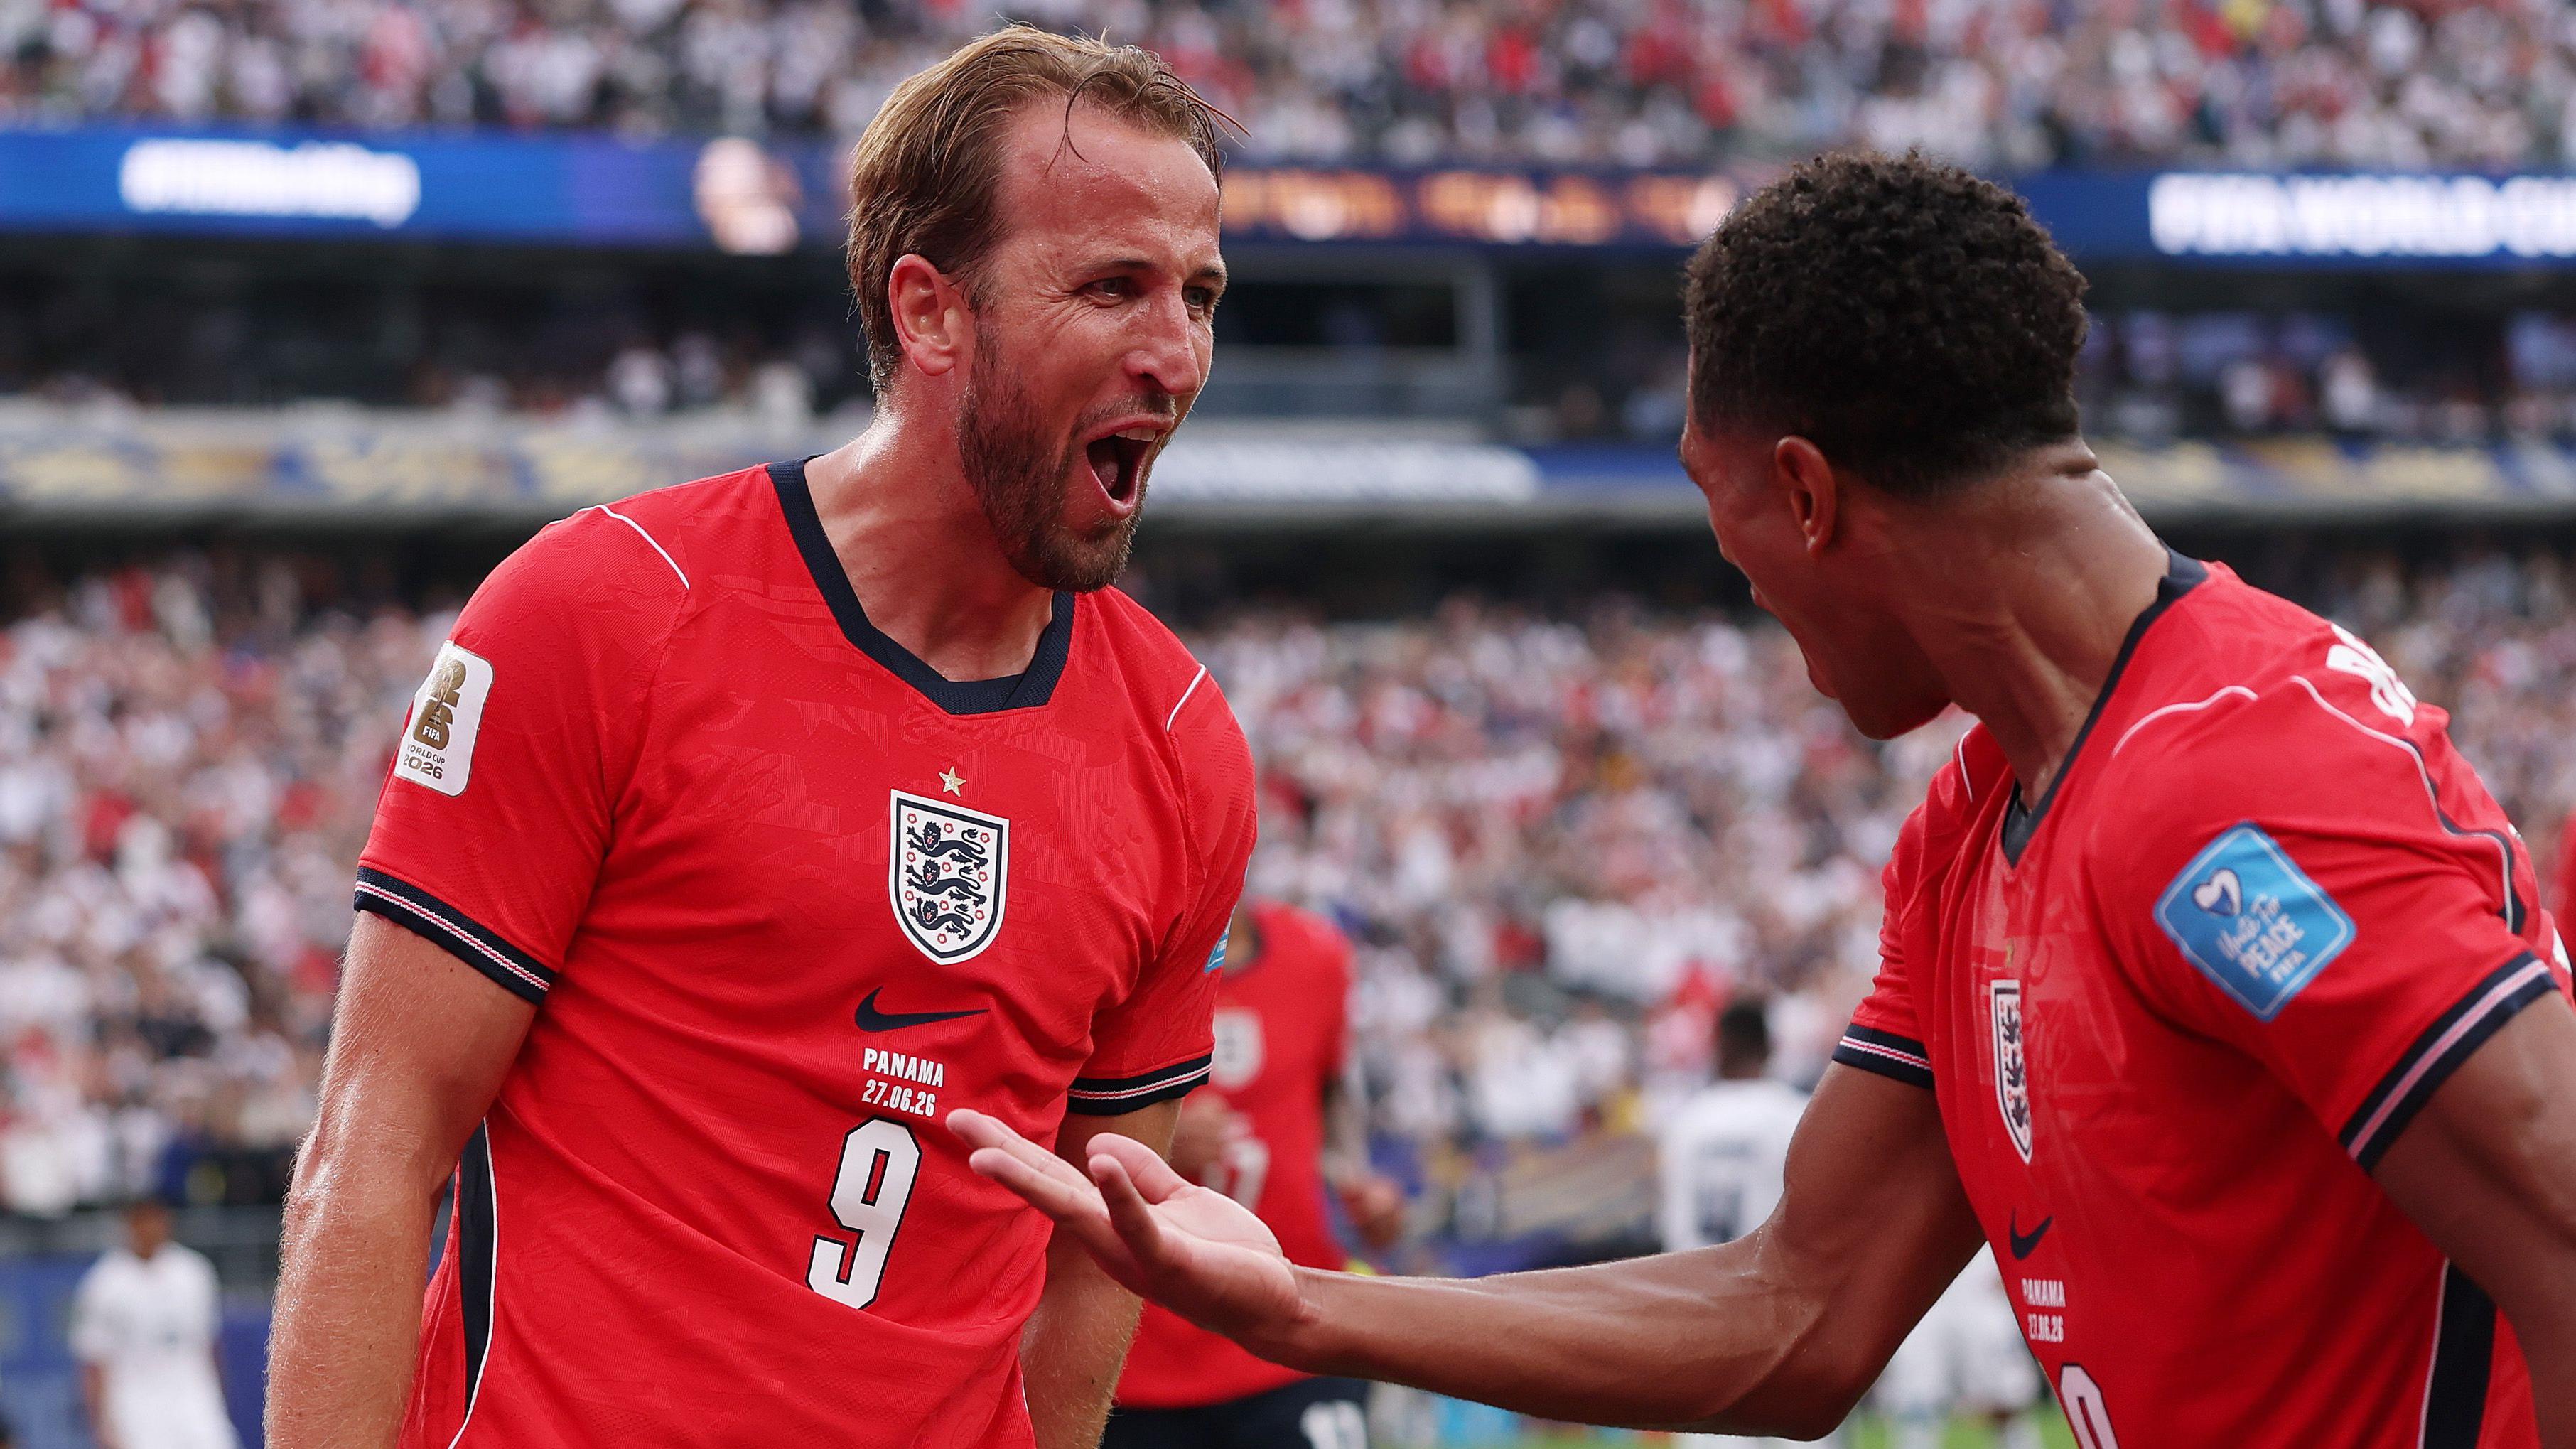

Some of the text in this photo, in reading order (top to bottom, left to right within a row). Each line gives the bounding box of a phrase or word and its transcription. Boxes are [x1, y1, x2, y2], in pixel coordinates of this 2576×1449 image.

[421, 725, 441, 742] FIFA
[403, 753, 443, 780] 2026
[433, 753, 446, 765] CUP
[2238, 913, 2305, 979] PEACE
[2269, 949, 2307, 984] FIFA
[862, 1047, 944, 1087] PANAMA
[861, 1079, 937, 1118] 27.06.26
[806, 1116, 922, 1310] 9
[2021, 1278, 2066, 1308] PANAMA
[2027, 1313, 2064, 1342] 27.06.26
